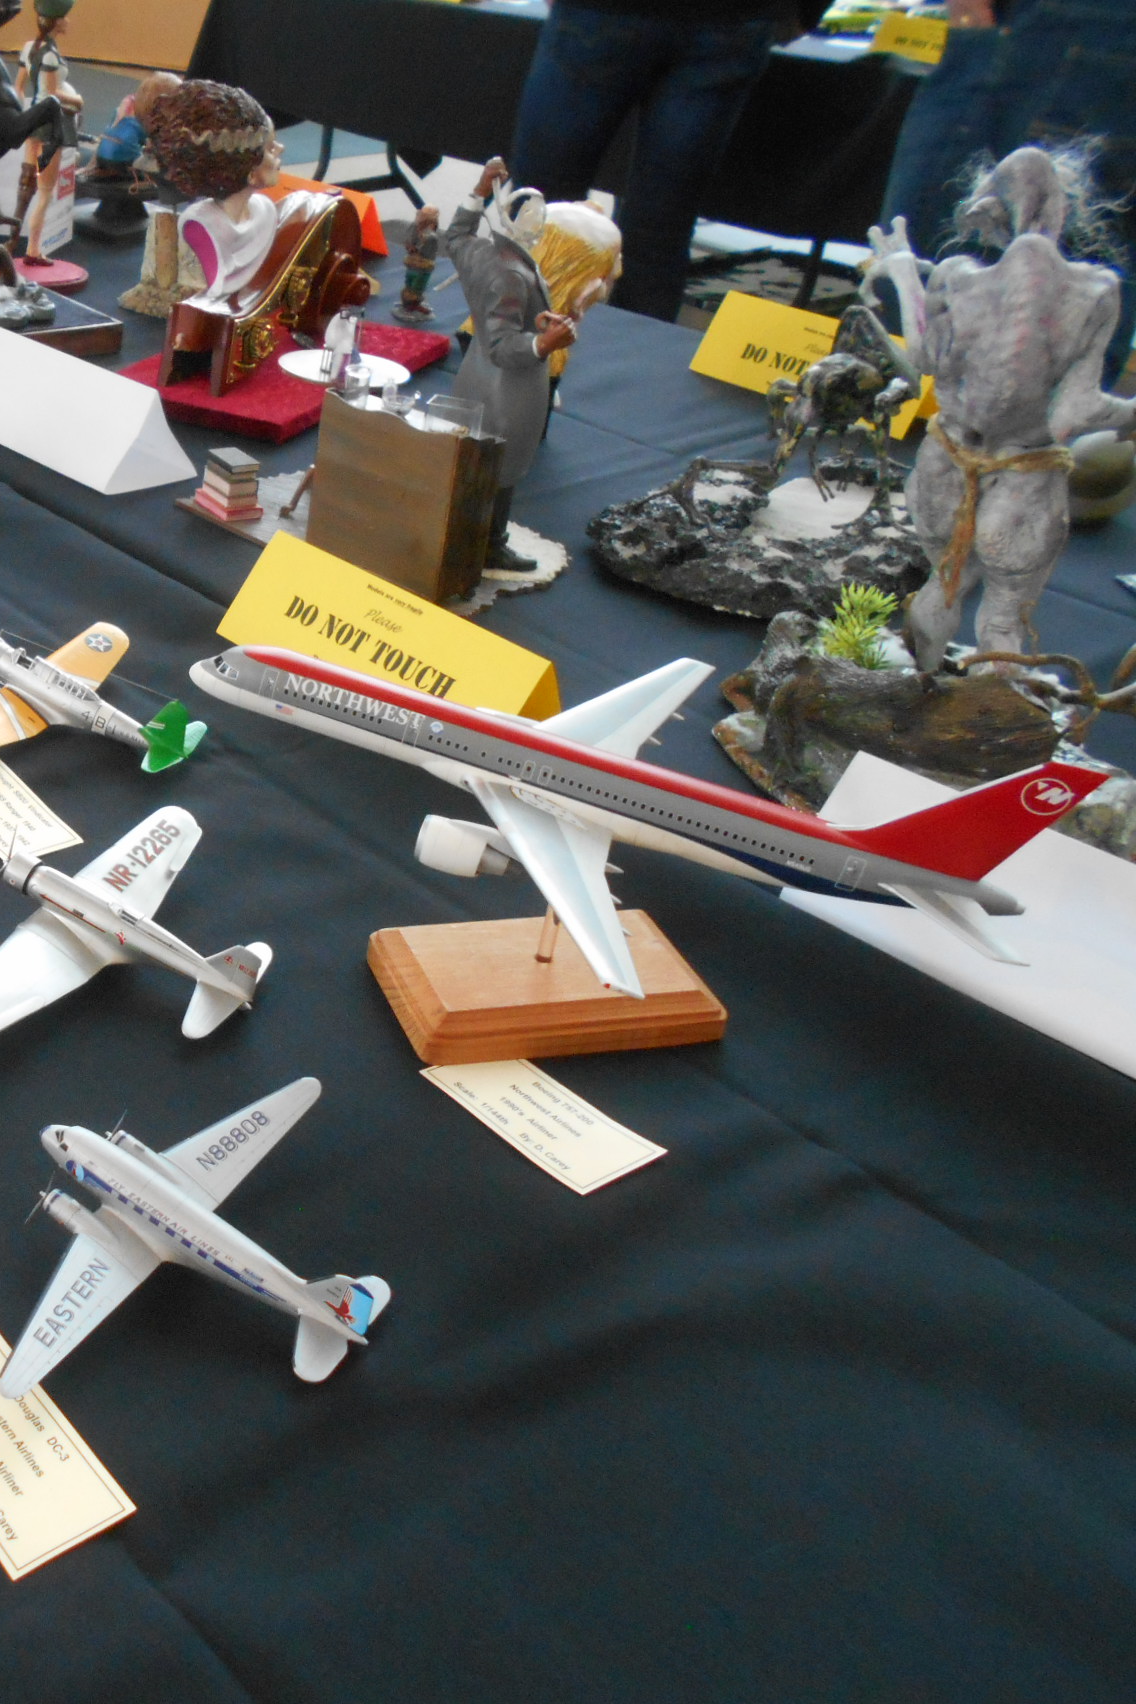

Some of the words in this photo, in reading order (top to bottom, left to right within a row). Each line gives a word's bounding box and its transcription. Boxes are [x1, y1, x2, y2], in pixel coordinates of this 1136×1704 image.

[741, 343, 767, 363] DO
[769, 349, 809, 376] NOT
[284, 595, 319, 627] DO
[317, 613, 372, 654] NOT
[368, 637, 457, 699] TOUCH
[364, 608, 403, 634] Please
[284, 673, 426, 730] NORTHWEST
[510, 1084, 550, 1115] Northwest
[551, 1114, 581, 1137] Airlines
[527, 1117, 557, 1140] Airliner
[532, 1081, 560, 1104] Boeing
[561, 1100, 594, 1126] 757-200
[196, 1109, 270, 1172] N88808
[481, 1102, 508, 1125] 1/144th
[545, 1152, 571, 1172] Carey
[127, 1192, 170, 1223] EASTERN
[32, 1257, 112, 1349] EASTERN
[14, 1394, 45, 1433] Douglas
[46, 1436, 70, 1462] DC-3
[14, 1439, 45, 1478] Airlines
